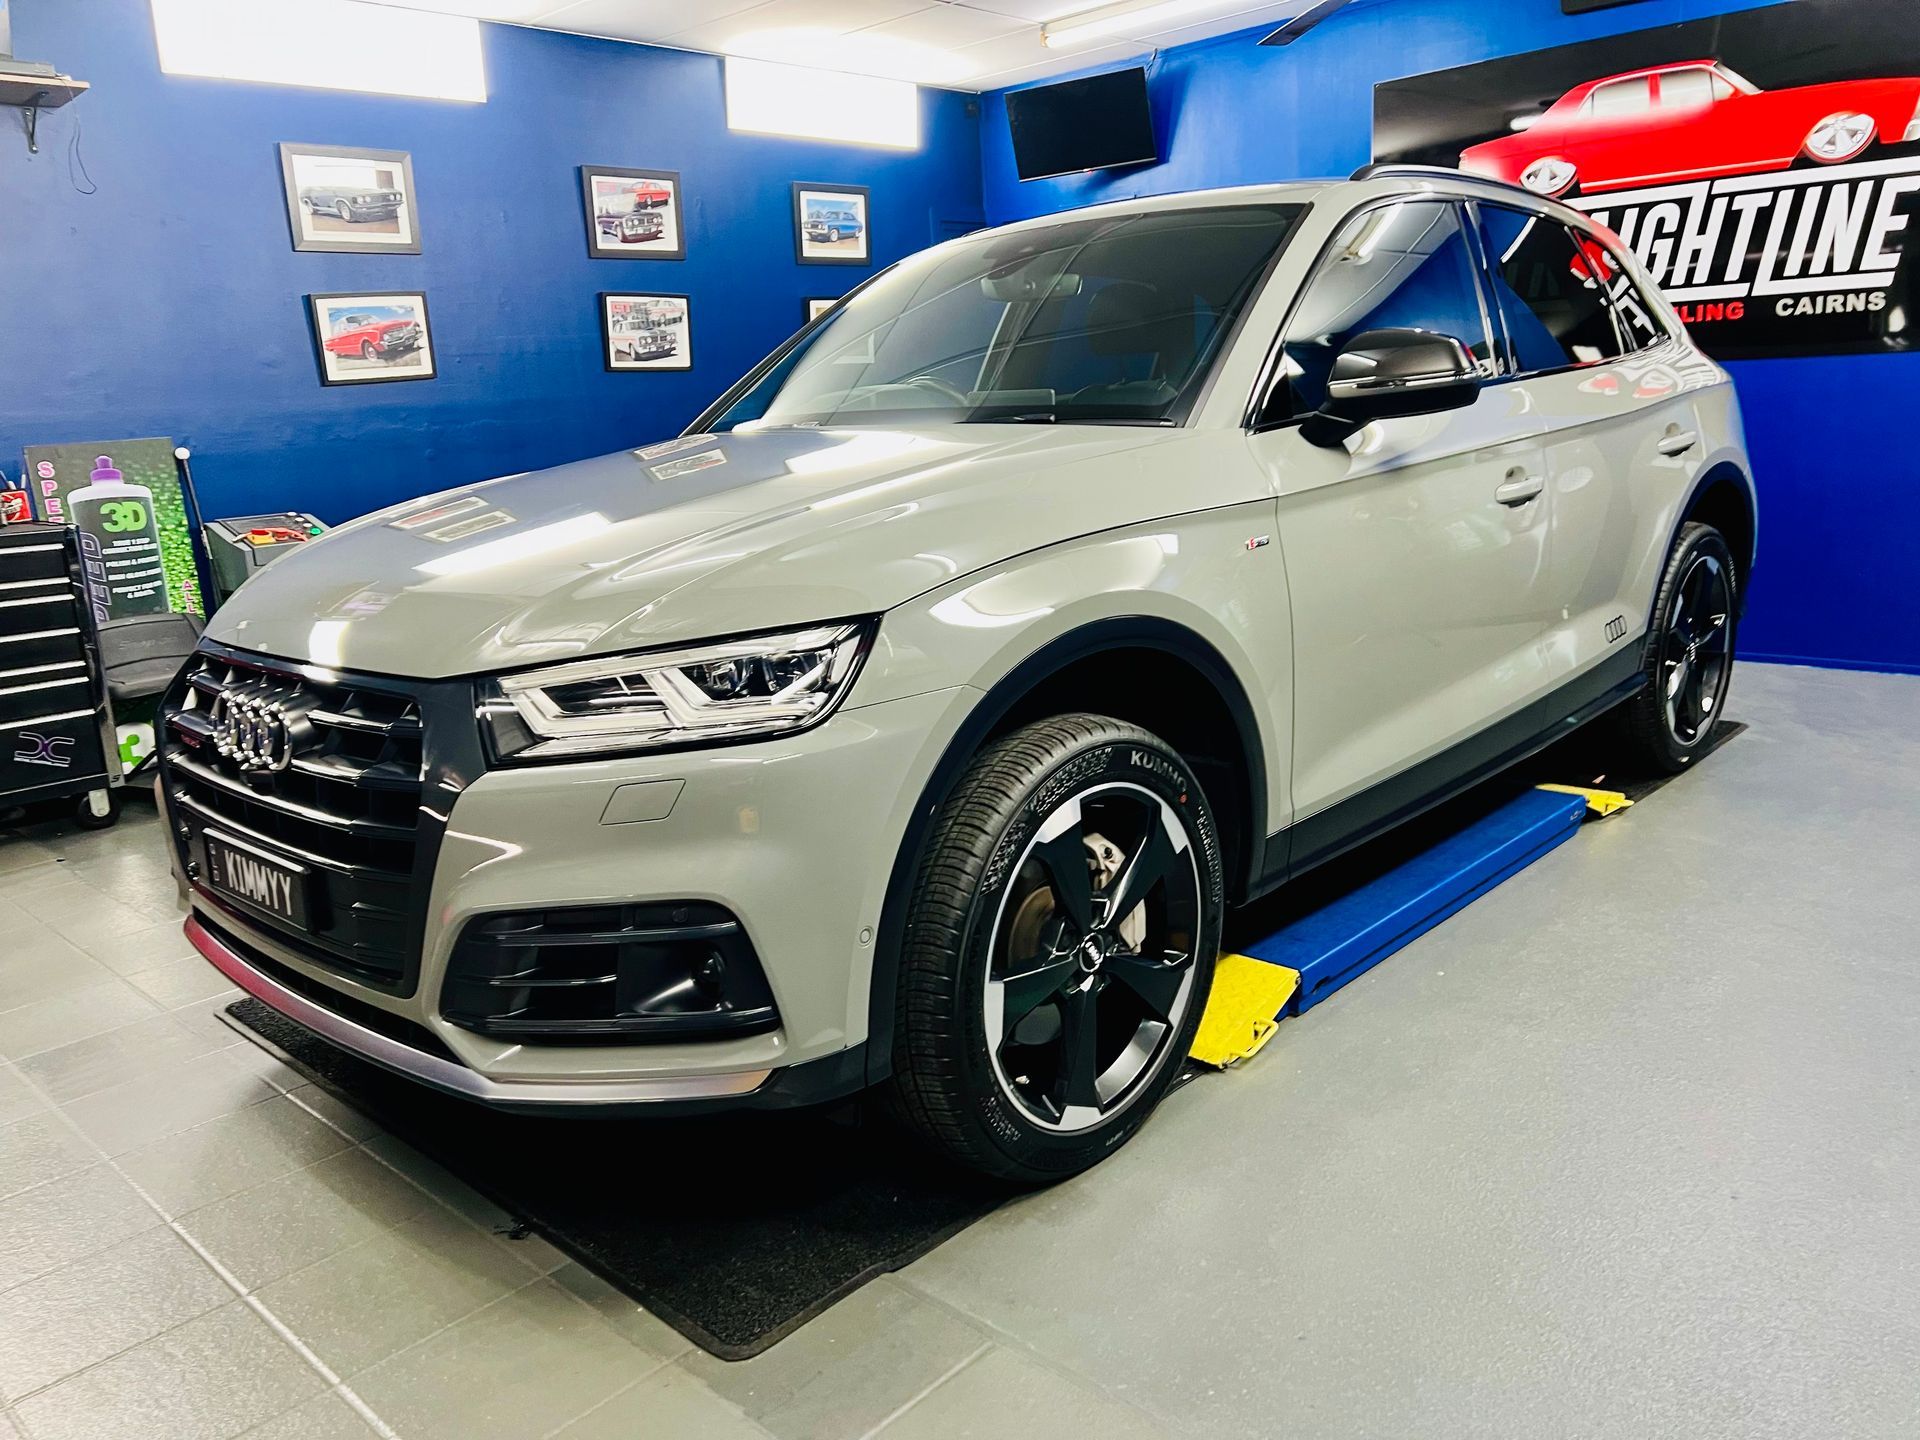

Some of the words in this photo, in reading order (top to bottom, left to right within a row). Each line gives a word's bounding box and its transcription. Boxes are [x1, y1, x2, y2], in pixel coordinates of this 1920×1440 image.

[1673, 301, 1745, 323] LING
[1775, 291, 1887, 318] CAIRNS
[100, 501, 147, 533] 3D
[182, 579, 196, 613] ALL
[1130, 750, 1188, 792] KUMHO
[224, 850, 292, 916] KIMMYY
